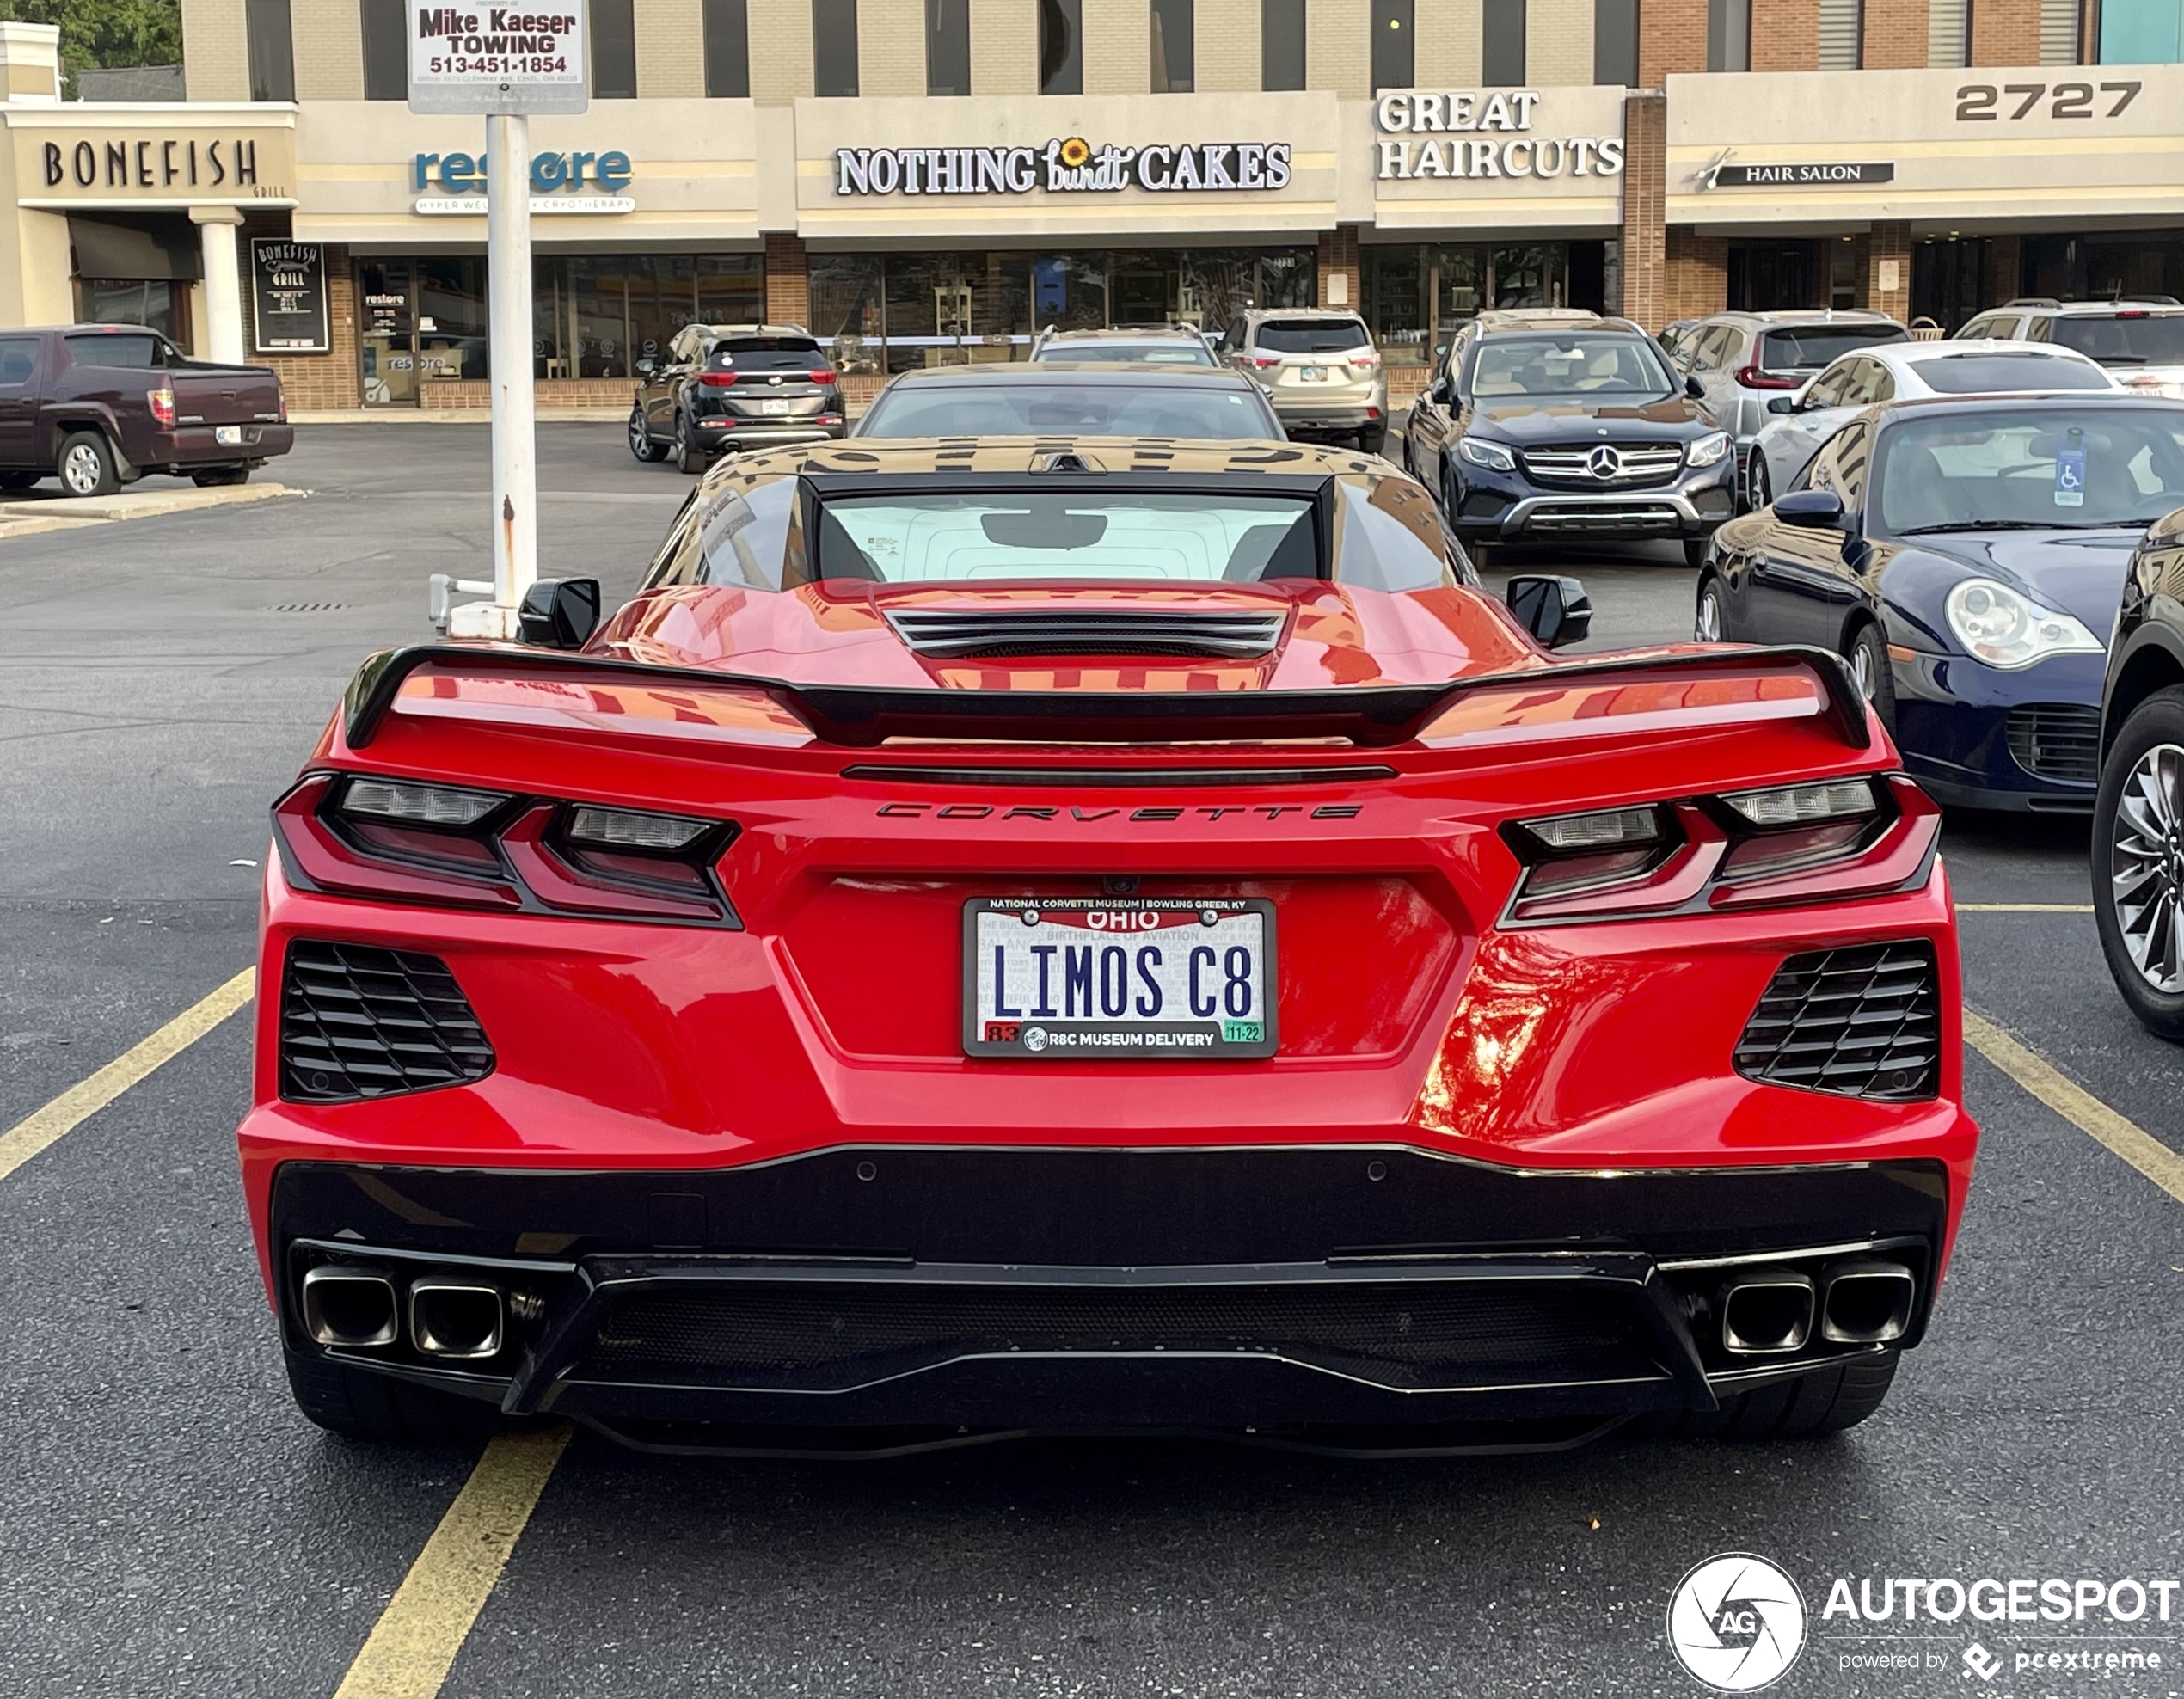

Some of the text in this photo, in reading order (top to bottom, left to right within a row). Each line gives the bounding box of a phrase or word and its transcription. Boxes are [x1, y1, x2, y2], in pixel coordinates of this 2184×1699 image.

[419, 9, 576, 39] Mike Kaeser
[446, 35, 555, 54] TOWING
[429, 56, 567, 74] 513-451-1854
[1955, 82, 2142, 121] 2727
[1377, 91, 1539, 132] GREAT
[44, 139, 257, 187] BONEFISH
[837, 138, 1291, 194] NOTHING bundt CAKES
[1377, 138, 1625, 179] HAIRCUTS
[1745, 164, 1862, 182] HAIR SALON
[254, 186, 286, 199] GRILL
[420, 200, 458, 210] HYPER
[543, 199, 631, 209] CRYOTHERAPY
[258, 244, 317, 263] BONEFISH
[272, 272, 305, 286] GRILL
[365, 293, 405, 304] restore
[388, 357, 445, 370] resore
[875, 801, 1365, 824] CORVETTE
[990, 899, 1041, 908] NATIONAL
[1042, 899, 1095, 908] CORVETTE
[1095, 899, 1140, 909] MUSEUM
[1146, 900, 1193, 909] BOWLING
[1194, 900, 1230, 910] GREEN,
[1232, 900, 1247, 909] KY
[1085, 911, 1160, 929] OHIO
[1046, 931, 1119, 942] BIRTHPLACE
[1142, 931, 1199, 942] AVIATION
[995, 945, 1252, 1018] LIMOS C8
[1049, 1033, 1215, 1046] R8C MUSEUM DELIVERY
